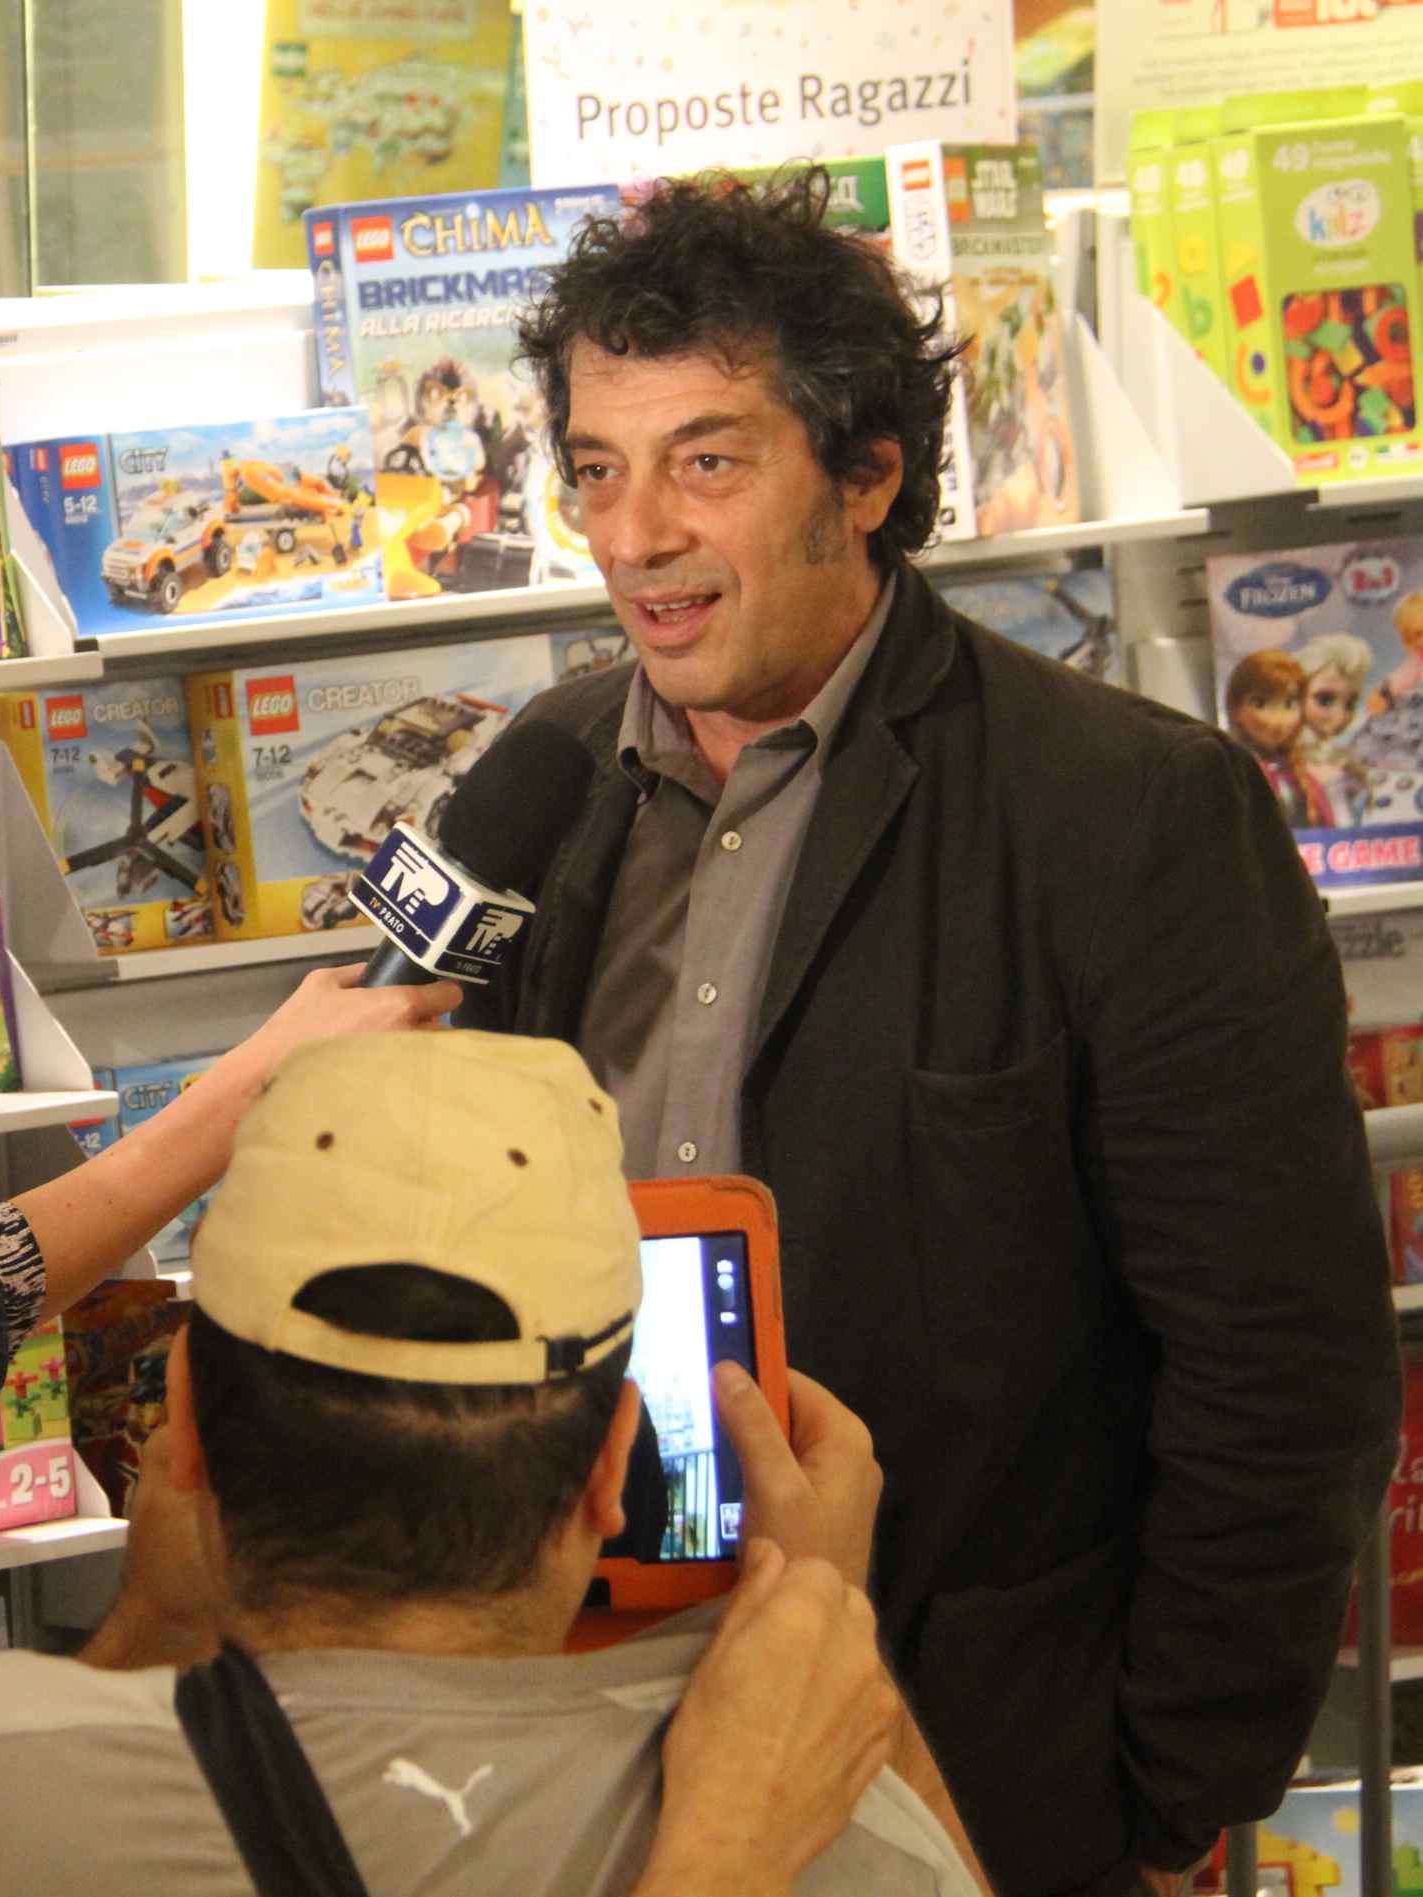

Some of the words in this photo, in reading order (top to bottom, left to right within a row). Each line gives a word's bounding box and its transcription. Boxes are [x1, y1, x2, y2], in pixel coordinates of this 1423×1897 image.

[577, 82, 780, 145] Proposte
[798, 58, 971, 126] Ragazzi
[358, 264, 553, 312] BRICKMAS
[360, 311, 421, 337] ALLA
[63, 455, 97, 476] LEGO
[63, 494, 97, 513] 5-12
[251, 692, 294, 717] LEGO
[306, 676, 420, 712] CREATOR
[49, 708, 82, 728] LEGO
[92, 696, 180, 722] CREATOR
[50, 746, 81, 763] 7-12
[252, 744, 292, 766] 7-12
[1327, 836, 1420, 873] GAME
[379, 908, 405, 935] PRATO
[77, 1131, 102, 1150] -12
[10, 1456, 71, 1505] 2-5
